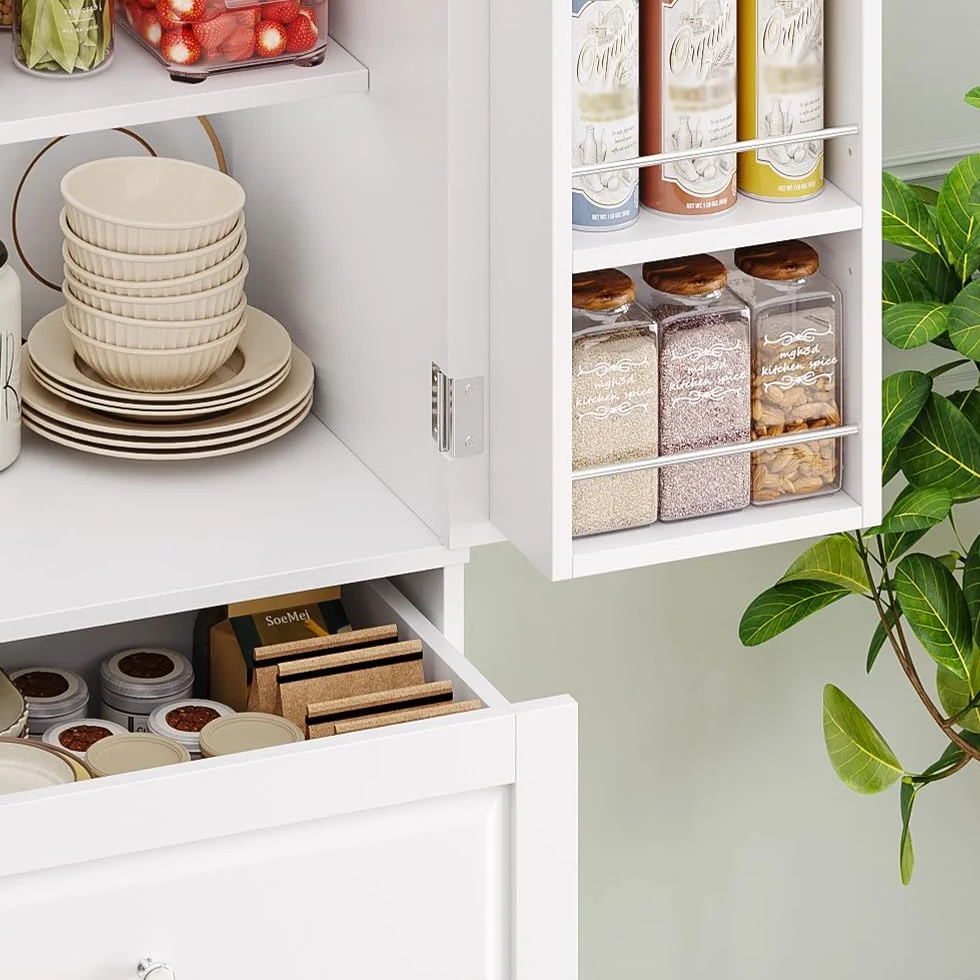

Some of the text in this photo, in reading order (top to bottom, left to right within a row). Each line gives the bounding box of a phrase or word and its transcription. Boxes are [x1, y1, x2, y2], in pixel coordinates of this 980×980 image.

[761, 356, 838, 376] kitchen spice
[670, 372, 746, 391] kitchen spice
[576, 387, 654, 407] kitchen spice
[265, 609, 310, 627] SoeMei
